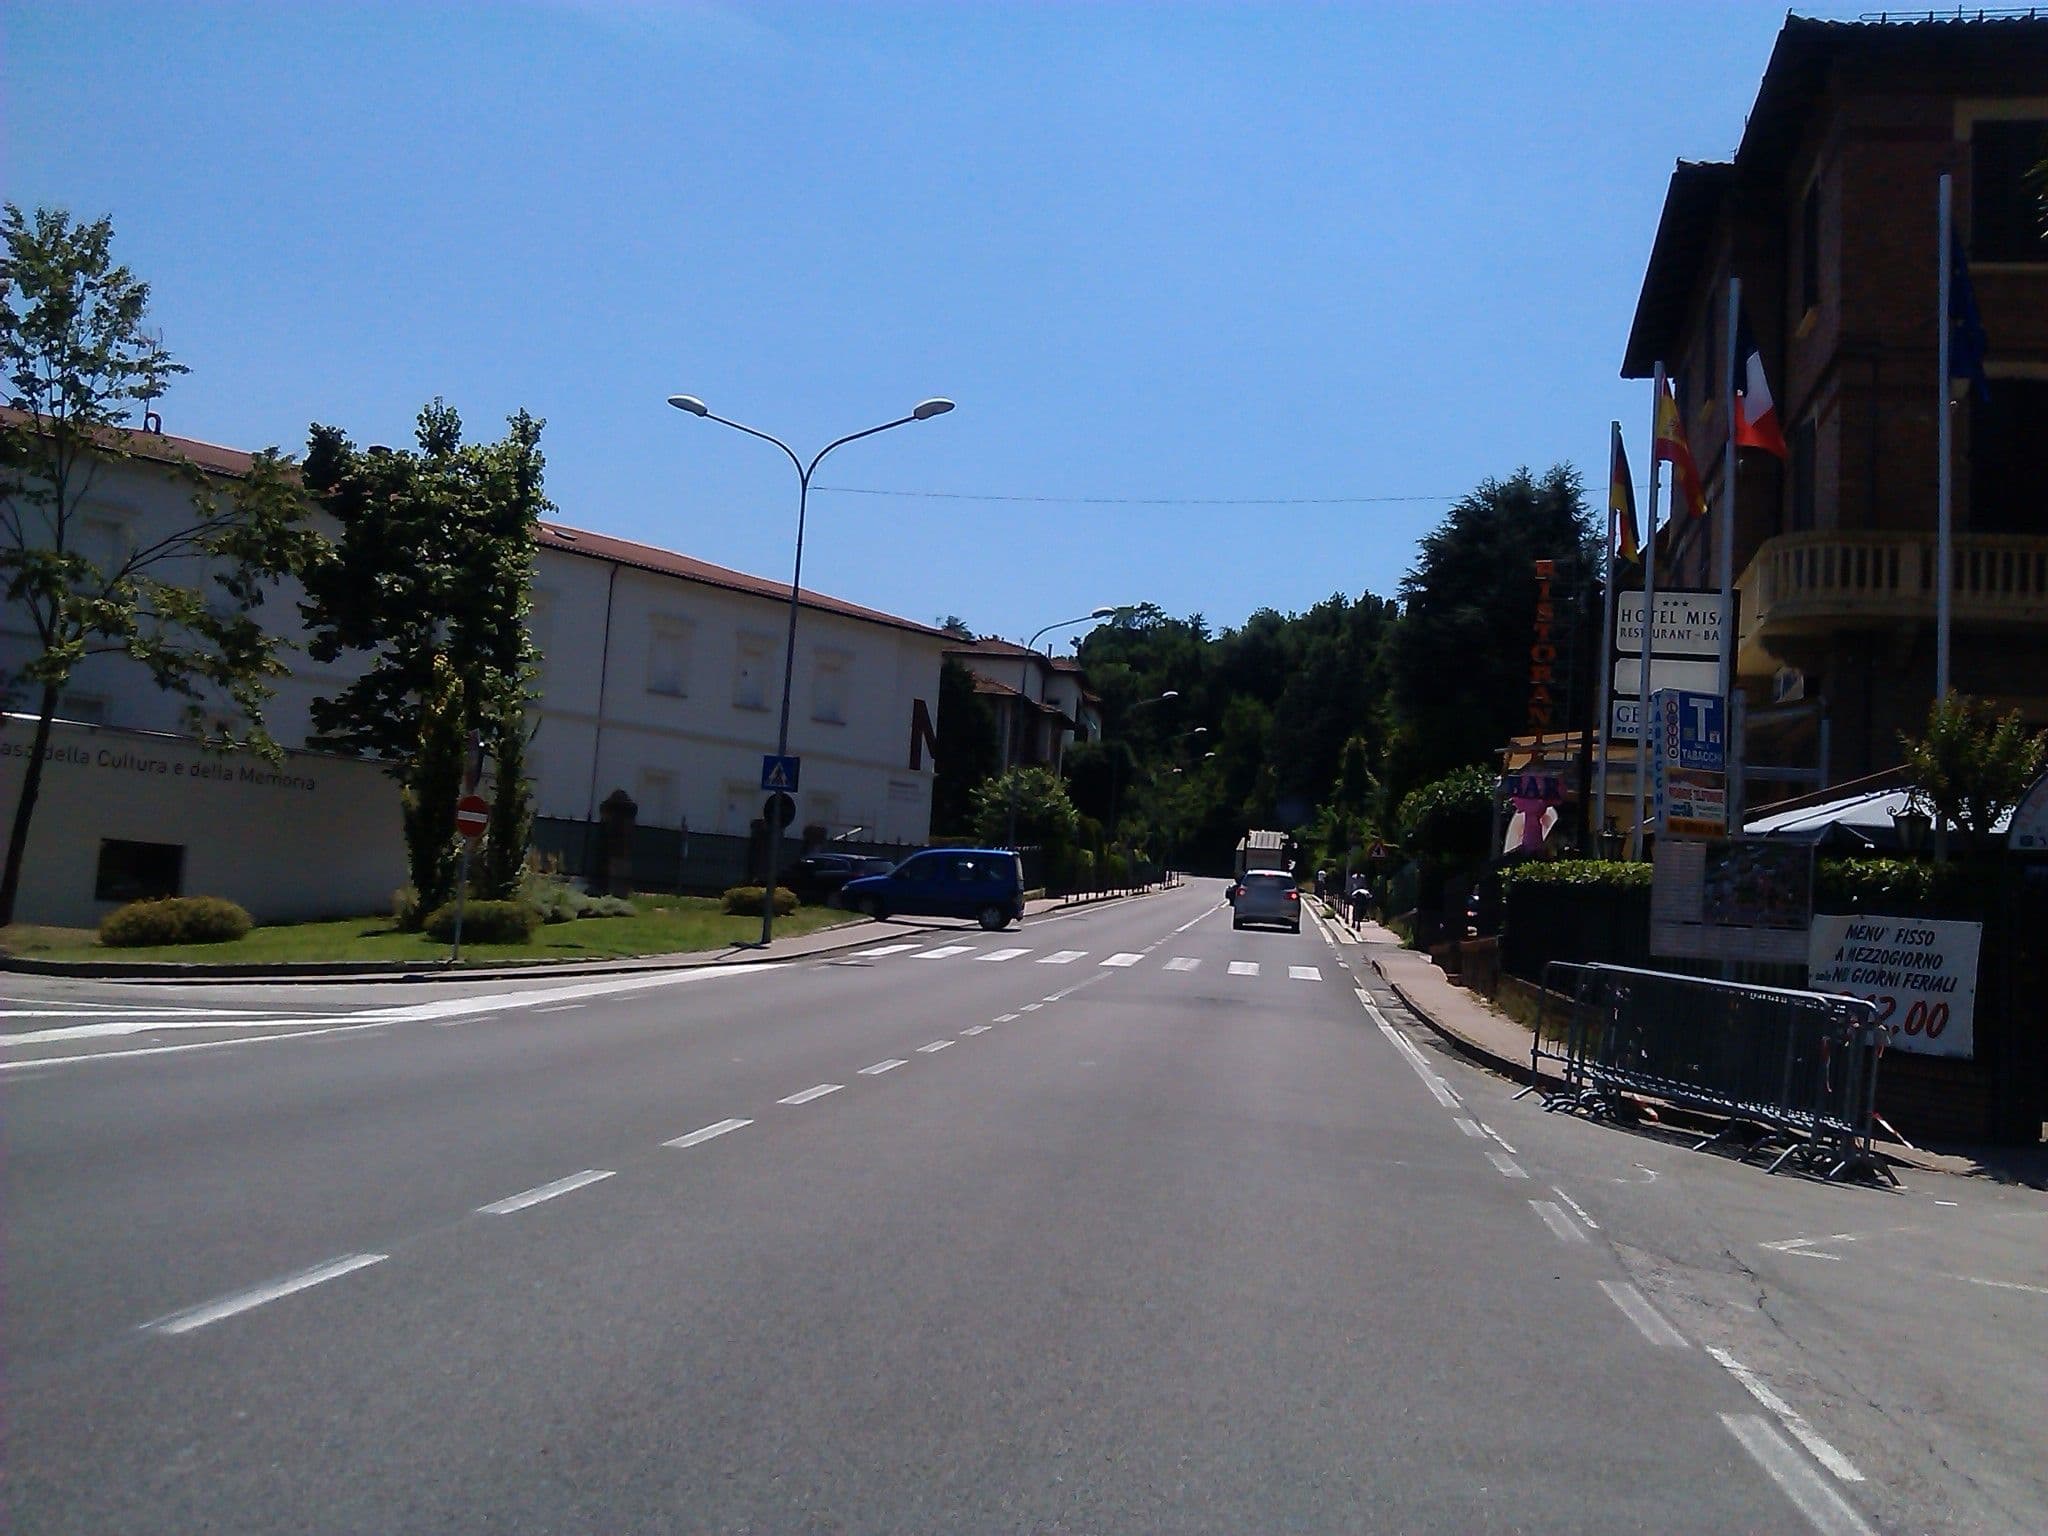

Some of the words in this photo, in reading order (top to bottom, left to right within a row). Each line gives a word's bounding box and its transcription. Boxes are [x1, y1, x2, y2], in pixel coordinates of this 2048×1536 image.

[1621, 609, 1677, 624] HOTEL
[1686, 611, 1722, 625] MIS
[1620, 627, 1692, 640] RESTURANT
[1703, 630, 1720, 641] BA
[1654, 694, 1665, 821] TABACCHI
[98, 749, 168, 774] Cultura
[174, 762, 185, 775] e
[190, 761, 233, 781] della
[239, 766, 316, 791] Memoria
[1506, 776, 1560, 798] BAR
[1894, 928, 1936, 947] FISSO
[1834, 946, 1845, 962] A
[1847, 947, 1945, 971] MEZZOGIORNO
[1851, 966, 1901, 988] GIORNI
[1902, 972, 1958, 993] FERIALI
